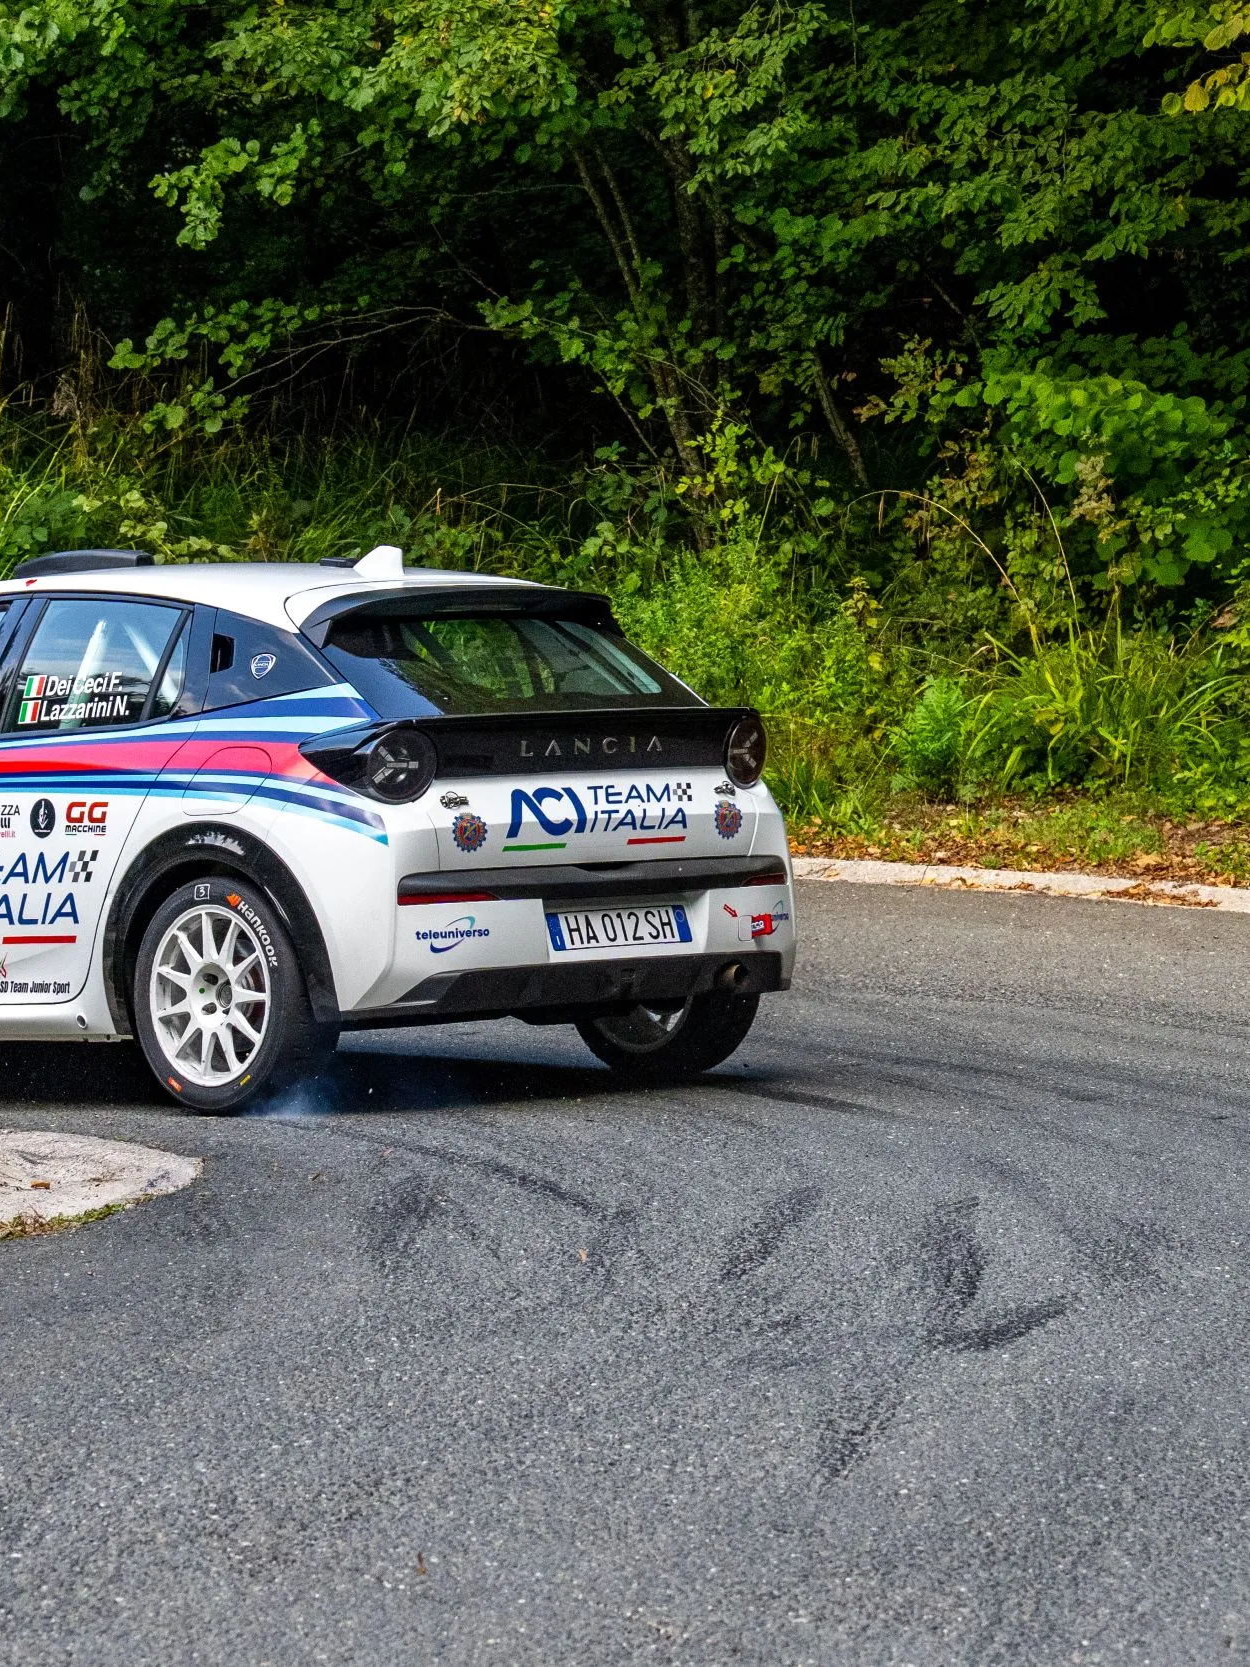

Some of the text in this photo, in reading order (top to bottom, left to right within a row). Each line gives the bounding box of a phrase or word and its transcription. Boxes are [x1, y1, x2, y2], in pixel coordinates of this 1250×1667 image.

[45, 671, 123, 696] Dei Ceci F.
[40, 694, 130, 721] Lazzarini N.
[520, 736, 662, 757] LANCIA
[66, 801, 109, 823] GG
[506, 783, 671, 839] ACI TEAM
[590, 807, 688, 832] ITALIA
[64, 824, 107, 833] MACCHINE
[415, 926, 490, 941] teleuniverso
[564, 908, 676, 946] HA 012 SH
[10, 981, 29, 993] Team
[30, 980, 52, 994] Junior
[52, 981, 71, 995] Sport
